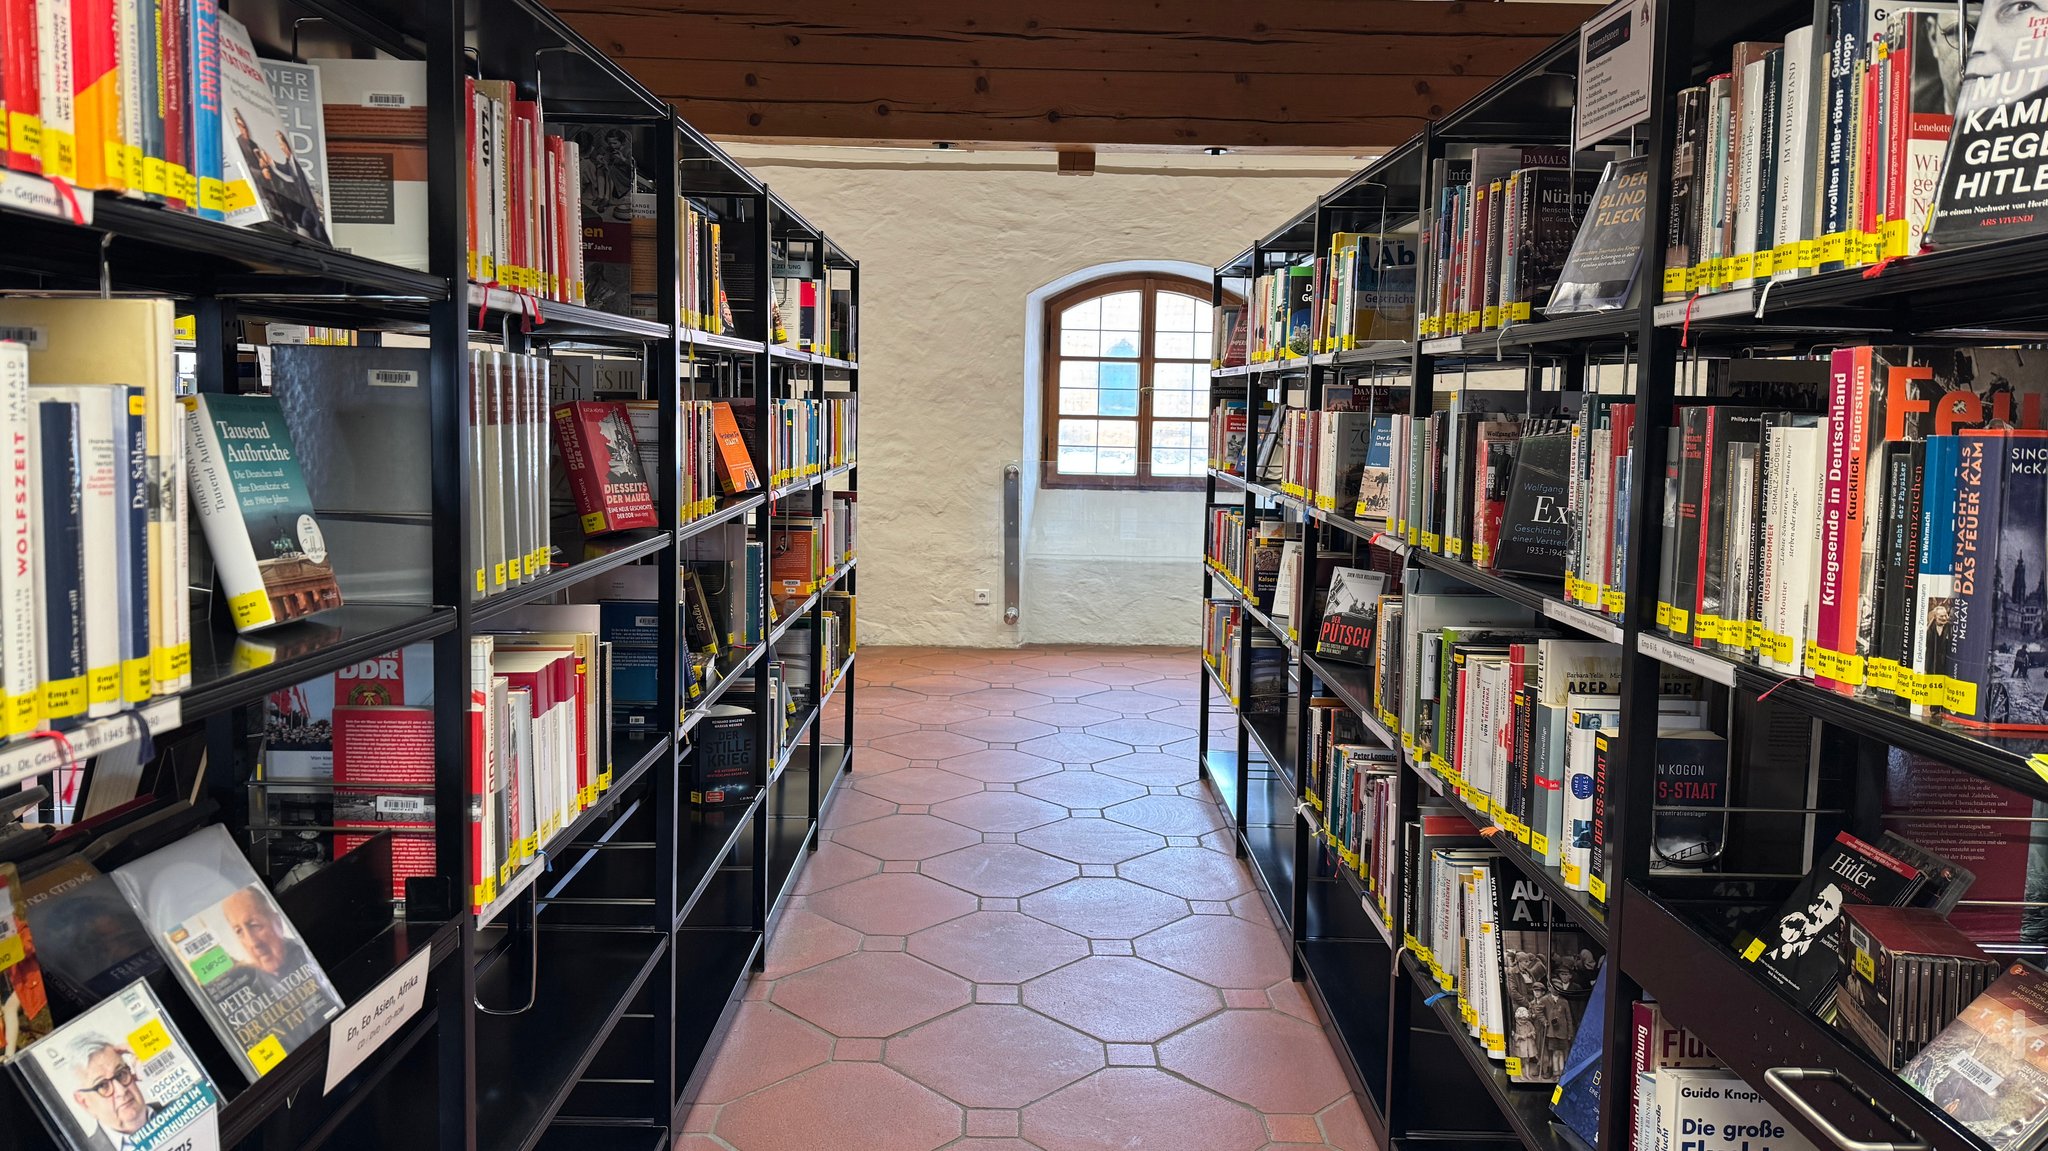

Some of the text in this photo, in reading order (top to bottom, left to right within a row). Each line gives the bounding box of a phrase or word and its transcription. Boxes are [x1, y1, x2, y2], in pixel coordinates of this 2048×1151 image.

[198, 14, 219, 117] ZUKUNFT
[1831, 41, 1842, 79] Guido
[1840, 33, 1855, 76] Knopp
[1833, 89, 1845, 124] töten
[1780, 62, 1797, 203] Benz IM WIDERSTAND
[1523, 154, 1568, 165] DAMALS
[1723, 109, 1738, 224] NIEDER MIT HITLER!
[1743, 149, 1754, 193] ich noch
[1617, 170, 1649, 191] DER
[1672, 180, 1680, 198] Die
[1827, 167, 1840, 219] wollten
[1888, 176, 1898, 217] Widerstand
[1594, 207, 1645, 229] FLECK
[1949, 202, 2027, 217] einem Nachwort von
[1980, 215, 2034, 227] ARS VIVENDI
[216, 420, 272, 441] Tausend
[1847, 364, 1866, 521] Kucklick Feuersturm
[131, 431, 145, 510] Das Schloss
[227, 443, 292, 464] Aufbrüche
[207, 465, 226, 513] Tausend
[604, 482, 648, 494] DIESSEITS
[1523, 482, 1564, 494] Wolfgang
[1771, 436, 1781, 516] SCHMALZ-JACOBSEN
[1822, 371, 1848, 607] Kriegsende in Deutschland
[14, 432, 29, 577] WOLFSZEIT
[606, 492, 651, 505] DER MAUER
[1814, 472, 1826, 541] Ian Kershaw
[1893, 461, 1908, 567] Die Nacht der Physiker
[1514, 523, 1562, 537] Geschichte
[1789, 514, 1797, 531] oder
[1904, 465, 1924, 590] Flammenzeichen
[1952, 446, 1972, 593] DIE NACHT, ALS
[1962, 442, 1984, 596] DAS FEUER KAM
[1512, 535, 1535, 544] einer
[1921, 511, 1932, 565] Die Wehrmacht
[1763, 523, 1775, 602] RUSSENSOMMER
[1780, 580, 1788, 617] Moutier
[1902, 597, 1911, 648] FRIEDERICHS
[1915, 583, 1928, 664] Epkenhans Zimmermann
[1951, 598, 1961, 654] SINCLAIR
[1959, 598, 1970, 640] McKAY
[338, 659, 400, 680] DDR
[1912, 682, 1944, 691] Emp 616
[1912, 690, 1930, 698] Epke
[102, 725, 125, 742] 1945
[718, 731, 740, 741] DER
[1521, 694, 1532, 789] JAHRHUNDERTZEUGEN
[1539, 726, 1547, 761] Freiwillige
[707, 752, 749, 768] KRIEG
[1668, 764, 1705, 777] KOGON
[1582, 775, 1590, 798] LIMES
[1595, 754, 1607, 845] DER SS-STAAT
[1828, 852, 1877, 889] Hitler
[1490, 876, 1503, 963] AUSCHWITZ ALBUM
[218, 985, 257, 1017] PETER
[228, 963, 317, 1031] SCHOLL-LATOUR
[397, 975, 419, 1000] Afrika
[2010, 990, 2045, 1012] MAGISCHES
[237, 1020, 263, 1046] DER
[261, 997, 298, 1027] FLUCH
[295, 978, 321, 1001] DER
[282, 1005, 308, 1032] TAT
[150, 1066, 188, 1098] JOSCHKA
[159, 1074, 194, 1104] FISCHER
[1681, 1086, 1720, 1100] Guido
[129, 1086, 203, 1145] WILLKOMMEN IM
[148, 1096, 210, 1150] JAHRHUNDERT
[1682, 1118, 1786, 1142] Die große
